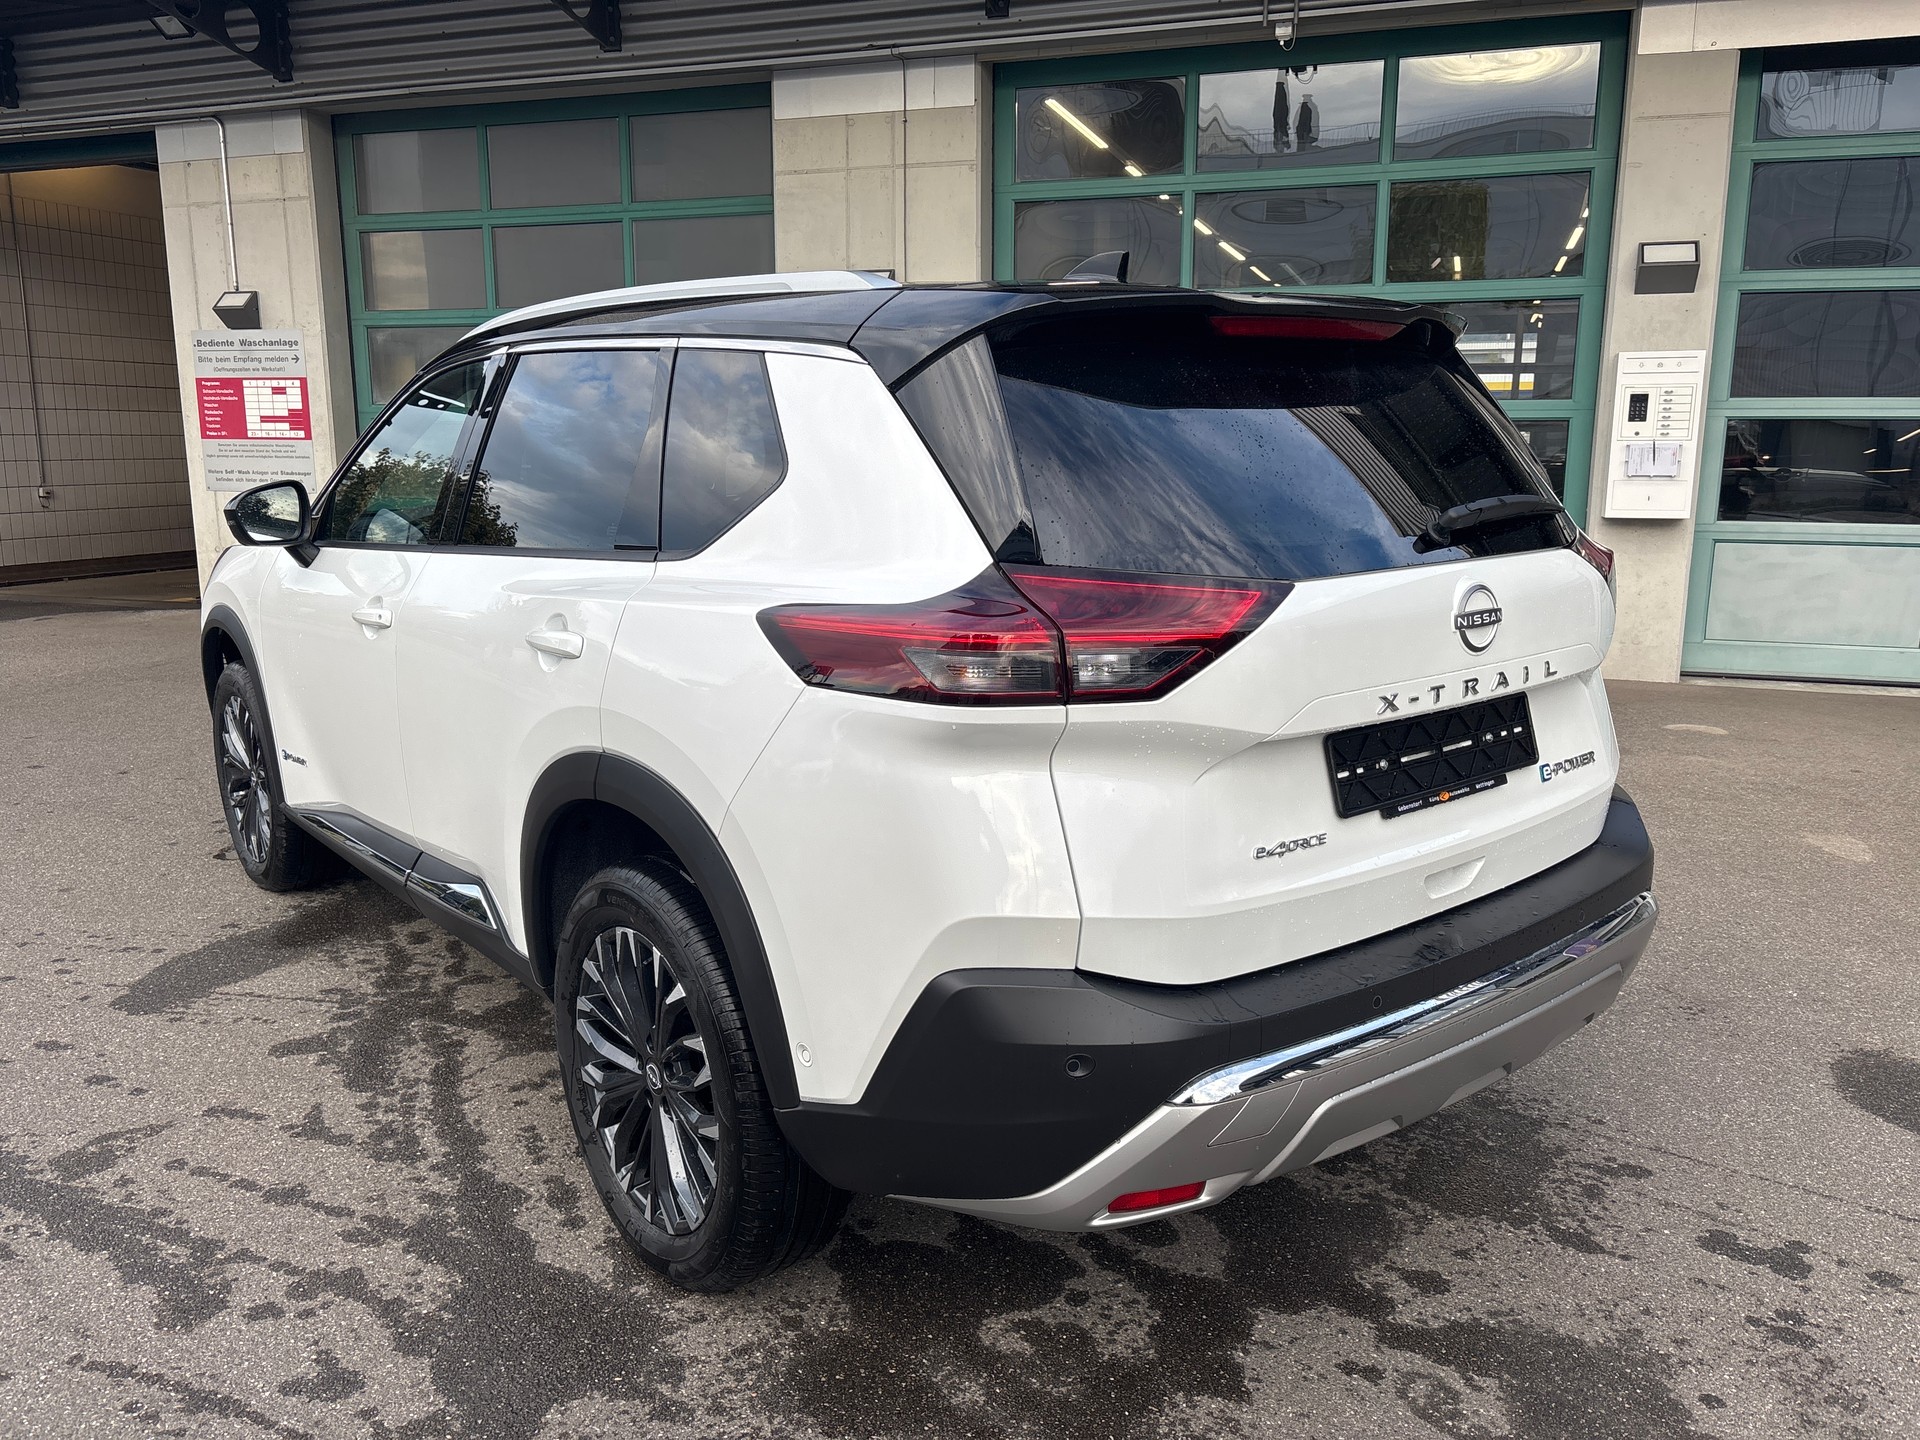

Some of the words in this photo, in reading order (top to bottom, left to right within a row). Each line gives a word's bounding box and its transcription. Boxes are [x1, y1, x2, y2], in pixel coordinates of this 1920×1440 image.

[197, 339, 235, 348] Bediente
[239, 338, 299, 348] Waschanlage
[198, 355, 213, 363] Bitte
[215, 355, 231, 363] beim
[233, 355, 262, 364] Empfang
[264, 355, 289, 363] melden
[1457, 609, 1502, 628] NISSAN
[1376, 660, 1558, 716] X-TRAIL
